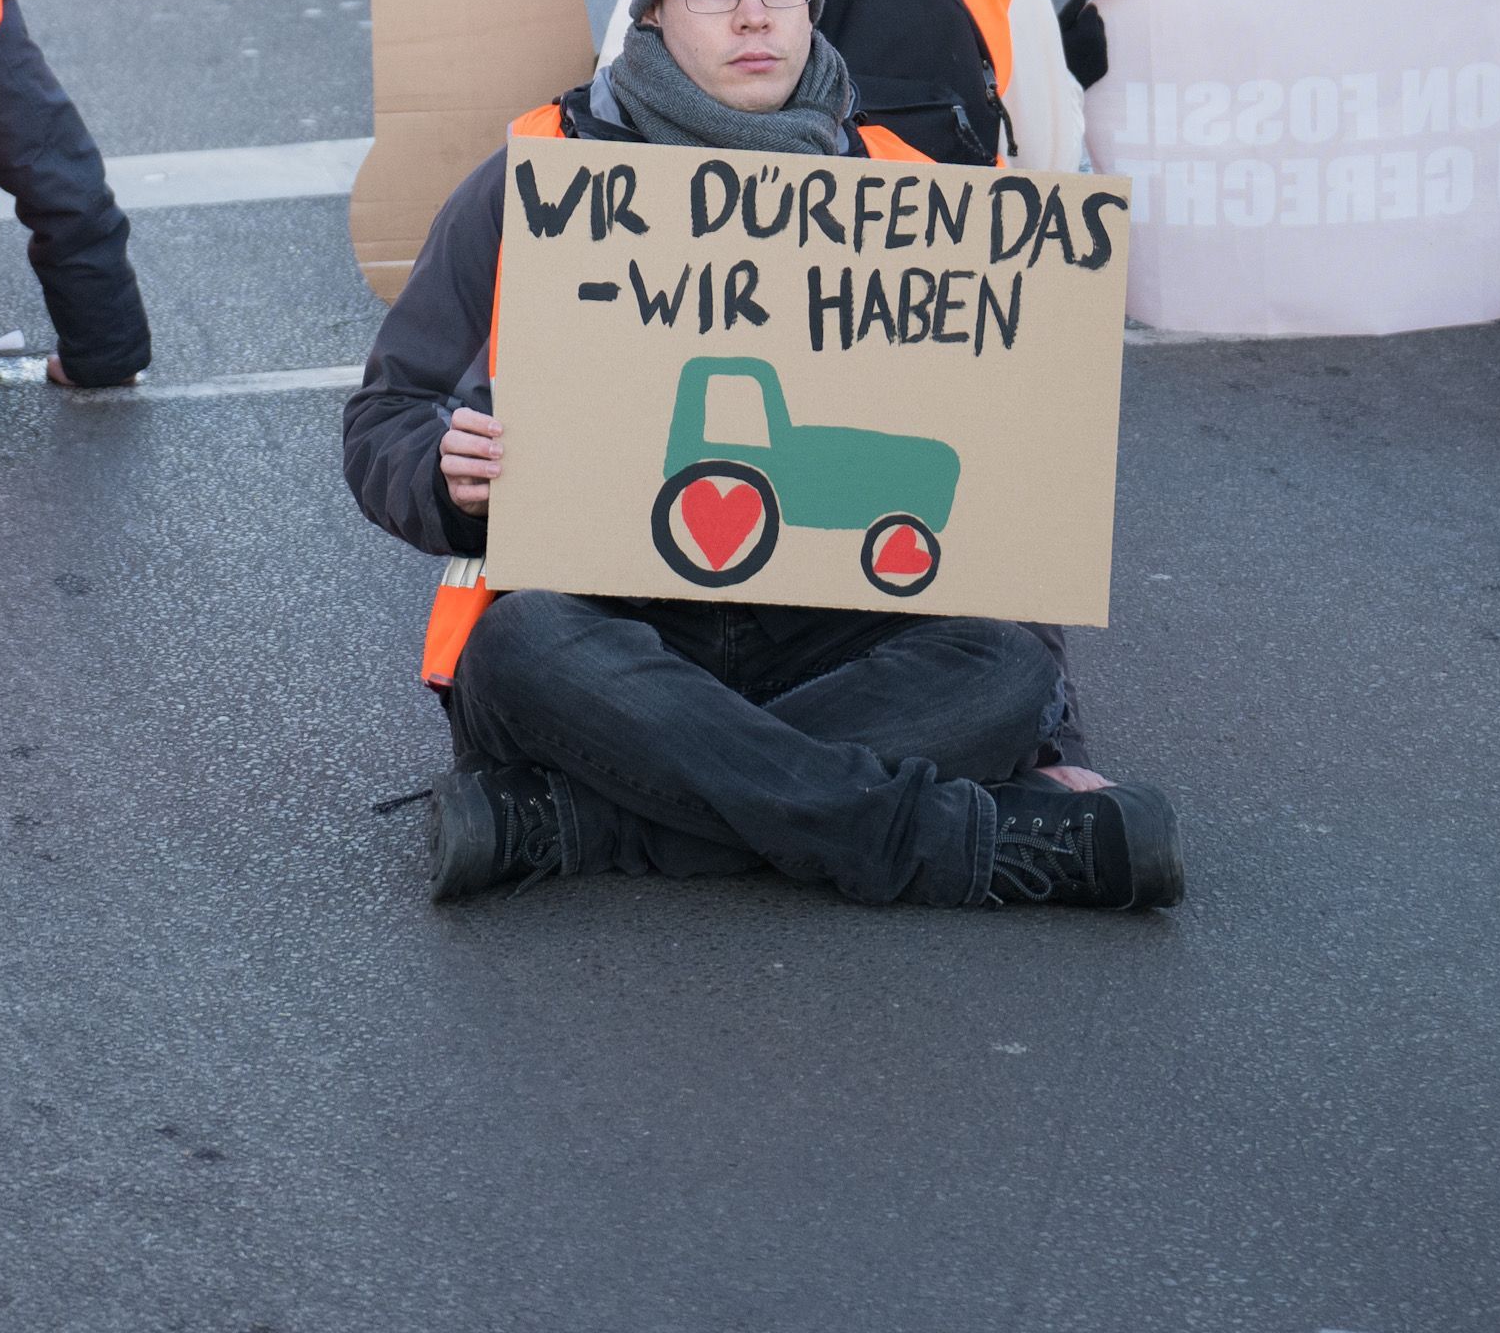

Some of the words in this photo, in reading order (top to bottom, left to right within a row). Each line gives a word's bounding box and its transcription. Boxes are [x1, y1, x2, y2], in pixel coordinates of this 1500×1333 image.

[514, 159, 649, 242] WIR
[691, 159, 973, 253] DÜRFEN
[989, 176, 1130, 269] DAS
[807, 267, 1022, 356] HABEN
